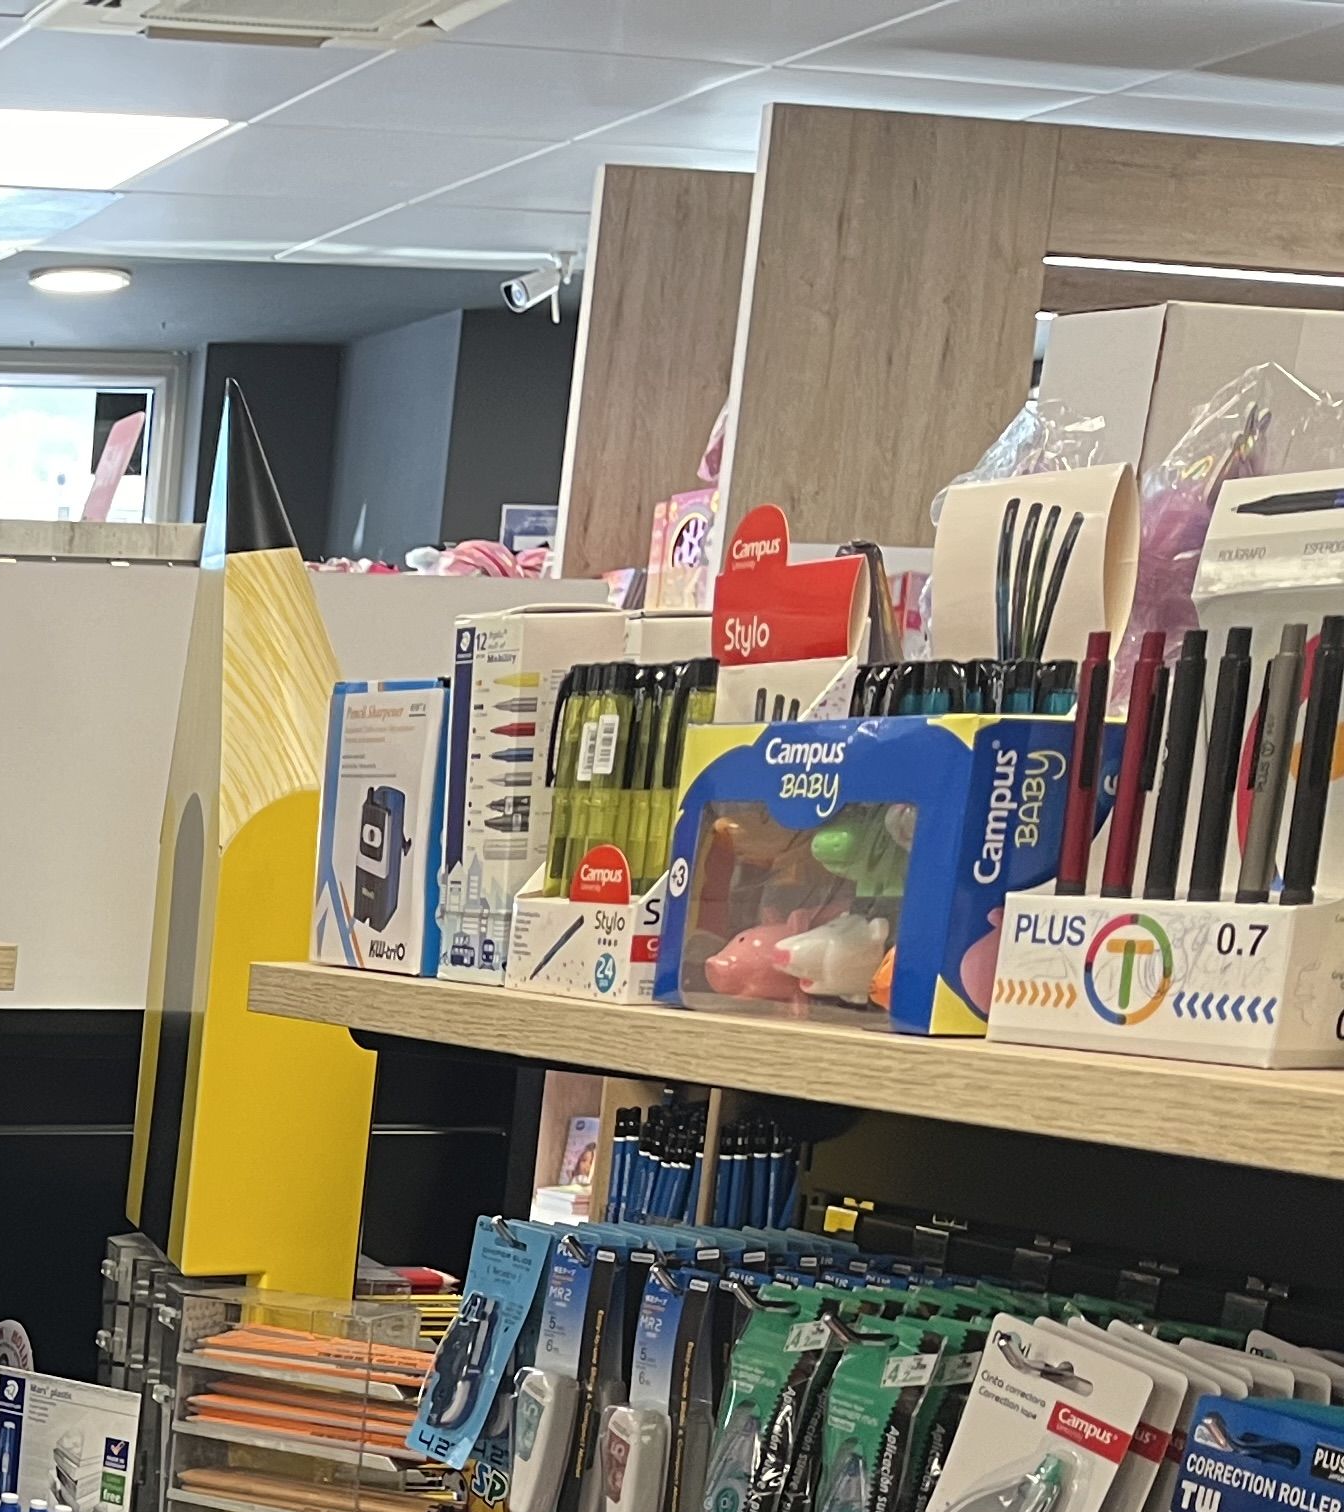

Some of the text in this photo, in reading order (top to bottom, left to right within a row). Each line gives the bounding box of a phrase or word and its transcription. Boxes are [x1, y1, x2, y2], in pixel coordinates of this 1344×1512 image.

[731, 536, 782, 562] Campus
[724, 616, 770, 656] Stylo
[765, 736, 846, 768] Campus
[780, 772, 840, 817] BABY
[1014, 749, 1067, 848] BABY
[973, 748, 1018, 886] Campus
[580, 864, 623, 887] Campus
[671, 865, 686, 888] +3
[594, 909, 626, 935] Stylo
[1014, 913, 1086, 946] PLUS
[1216, 922, 1268, 957] 0.7
[596, 957, 613, 980] 24
[548, 1285, 573, 1302] MR2
[548, 1316, 556, 1329] 5
[639, 1314, 663, 1333] MR2
[545, 1339, 554, 1352] 6
[981, 1369, 1005, 1388] Cinta
[978, 1385, 1020, 1412] Correction
[1057, 1407, 1113, 1445] Campus
[876, 1425, 901, 1498] Aplicación
[1186, 1453, 1276, 1500] CORRECTION
